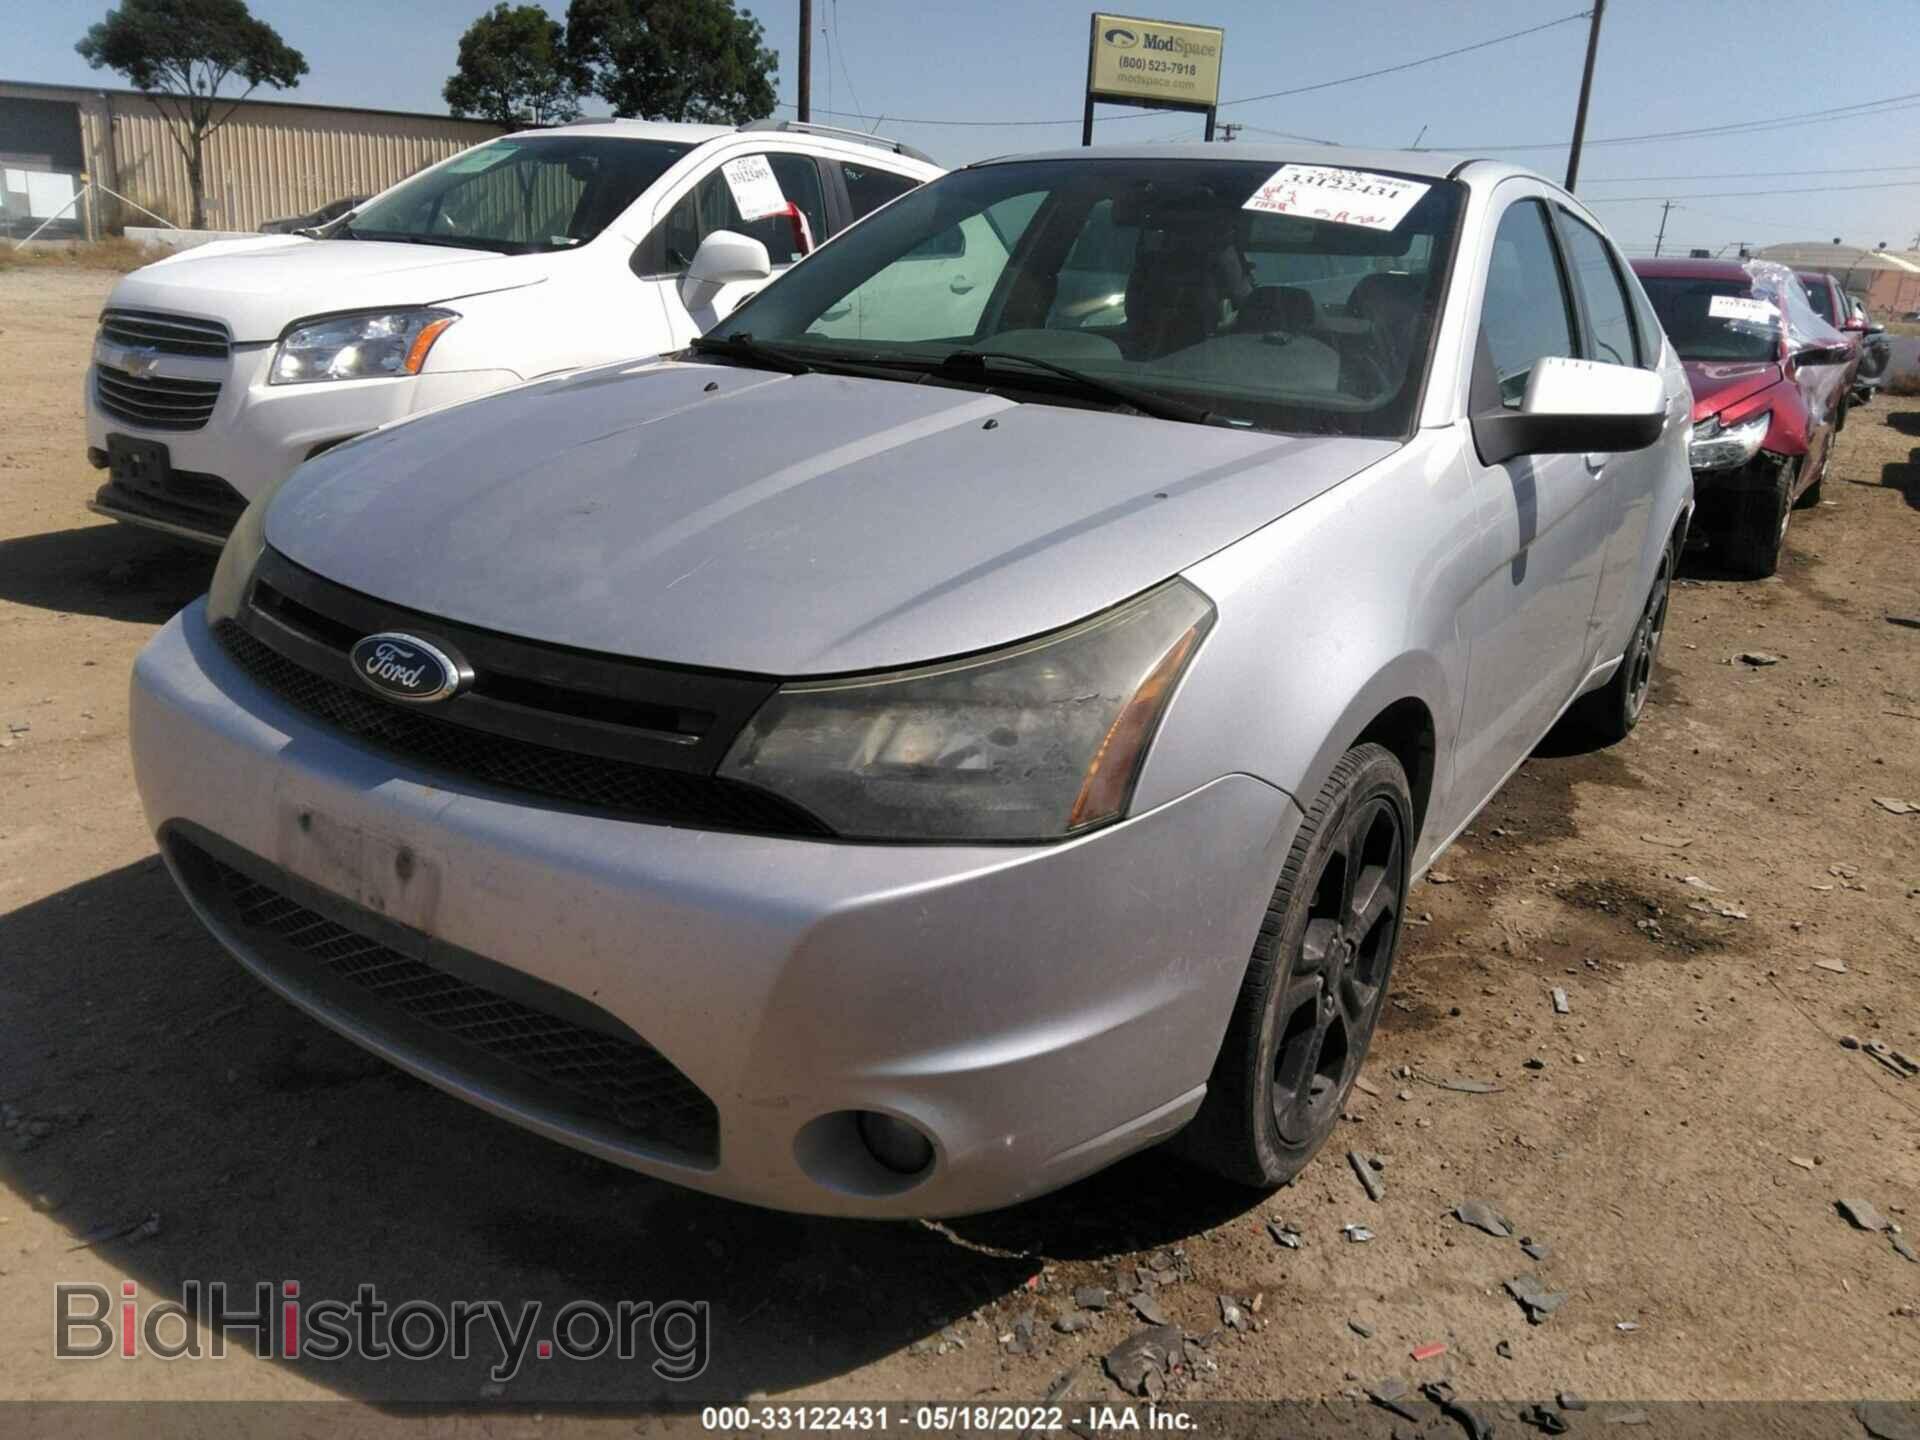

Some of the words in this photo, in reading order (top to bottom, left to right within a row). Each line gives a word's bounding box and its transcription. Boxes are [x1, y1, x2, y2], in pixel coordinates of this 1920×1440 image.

[1143, 33, 1216, 57] ModSpace
[1118, 55, 1147, 72] (800)
[1148, 57, 1196, 76] 523-7918
[366, 642, 426, 688] Ford
